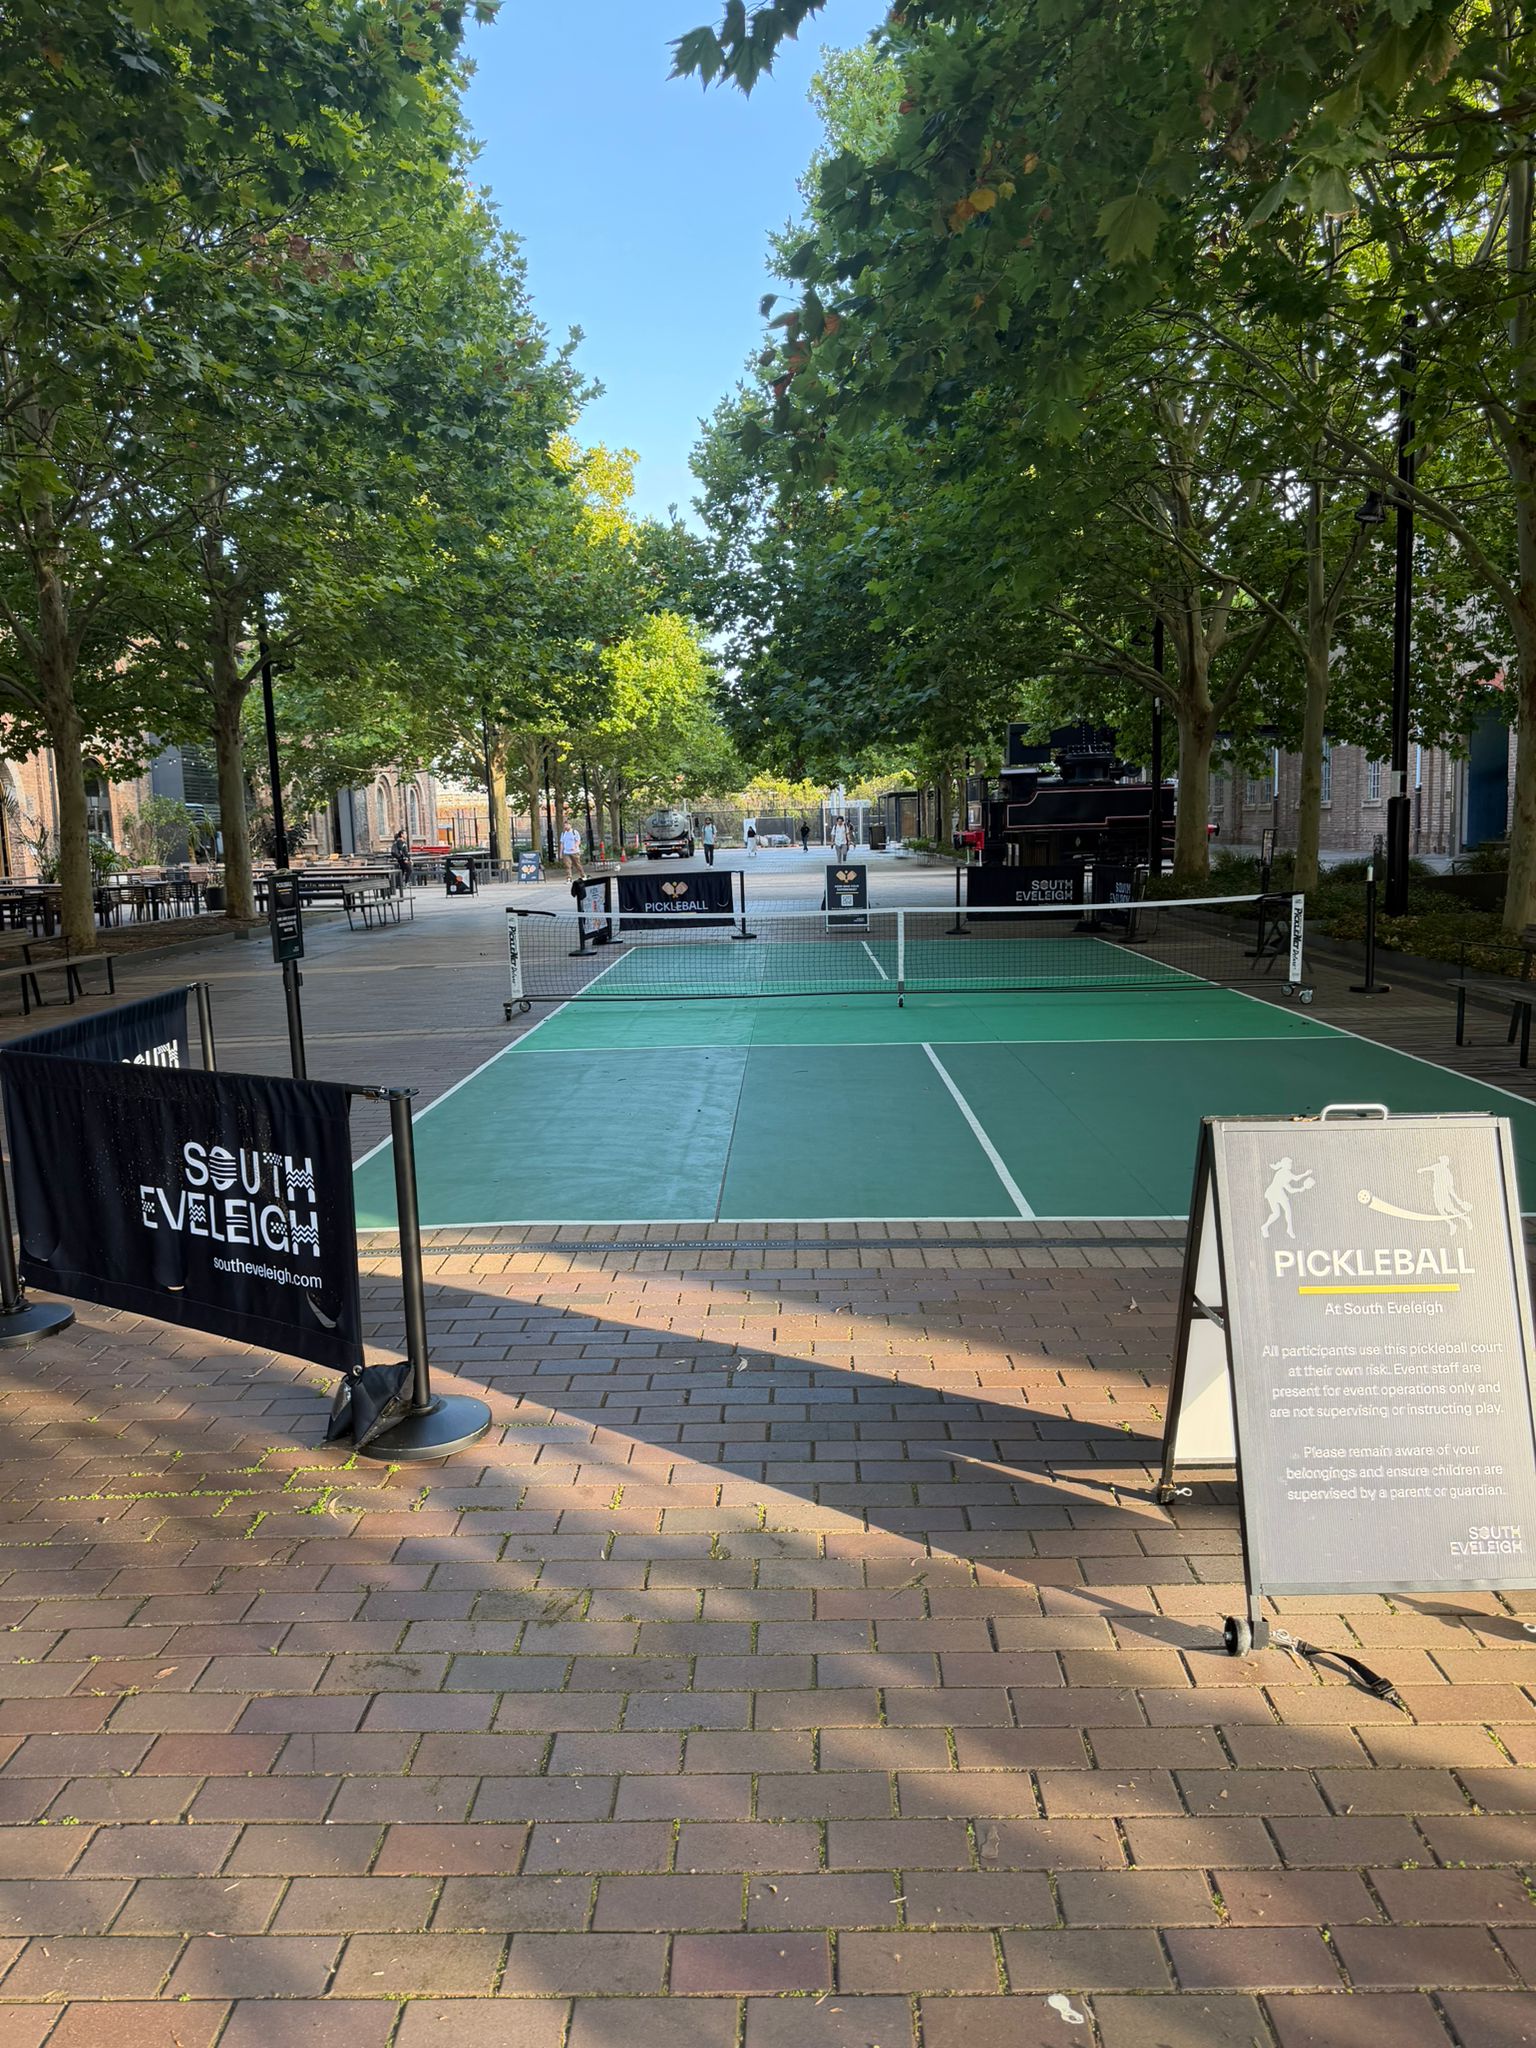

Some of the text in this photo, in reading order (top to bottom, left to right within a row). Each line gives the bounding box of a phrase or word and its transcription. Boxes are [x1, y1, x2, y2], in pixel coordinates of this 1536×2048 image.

[1031, 879, 1073, 890] SOUTH
[1015, 890, 1073, 901] EVELEIGH
[645, 900, 709, 912] PICKLEBALL
[183, 1141, 316, 1203] SOUTH
[139, 1185, 321, 1257] EVELEIGH
[1274, 1247, 1476, 1277] PICKLEBALL
[213, 1256, 323, 1289] southeveleigh.com
[1325, 1300, 1444, 1316] At South Eveleigh
[1282, 1344, 1356, 1359] participants
[1360, 1346, 1380, 1356] use
[1384, 1343, 1406, 1355] this
[1410, 1341, 1468, 1357] pickleball
[1471, 1342, 1503, 1353] court
[1288, 1366, 1302, 1376] at
[1304, 1365, 1332, 1376] their
[1335, 1365, 1362, 1376] own
[1394, 1363, 1428, 1375] Event
[1431, 1362, 1459, 1374] staff
[1462, 1363, 1481, 1374] are
[1272, 1381, 1501, 1400] present for event operations only and
[1270, 1401, 1504, 1419] are not supervising or instructing play.
[1303, 1443, 1480, 1458] Please remain aware of your
[1286, 1463, 1503, 1481] belongings and ensure children are
[1287, 1484, 1506, 1502] supervised by a parent or guardian.
[1468, 1524, 1521, 1540] SOUTH
[1450, 1540, 1523, 1555] EVELEIGH
